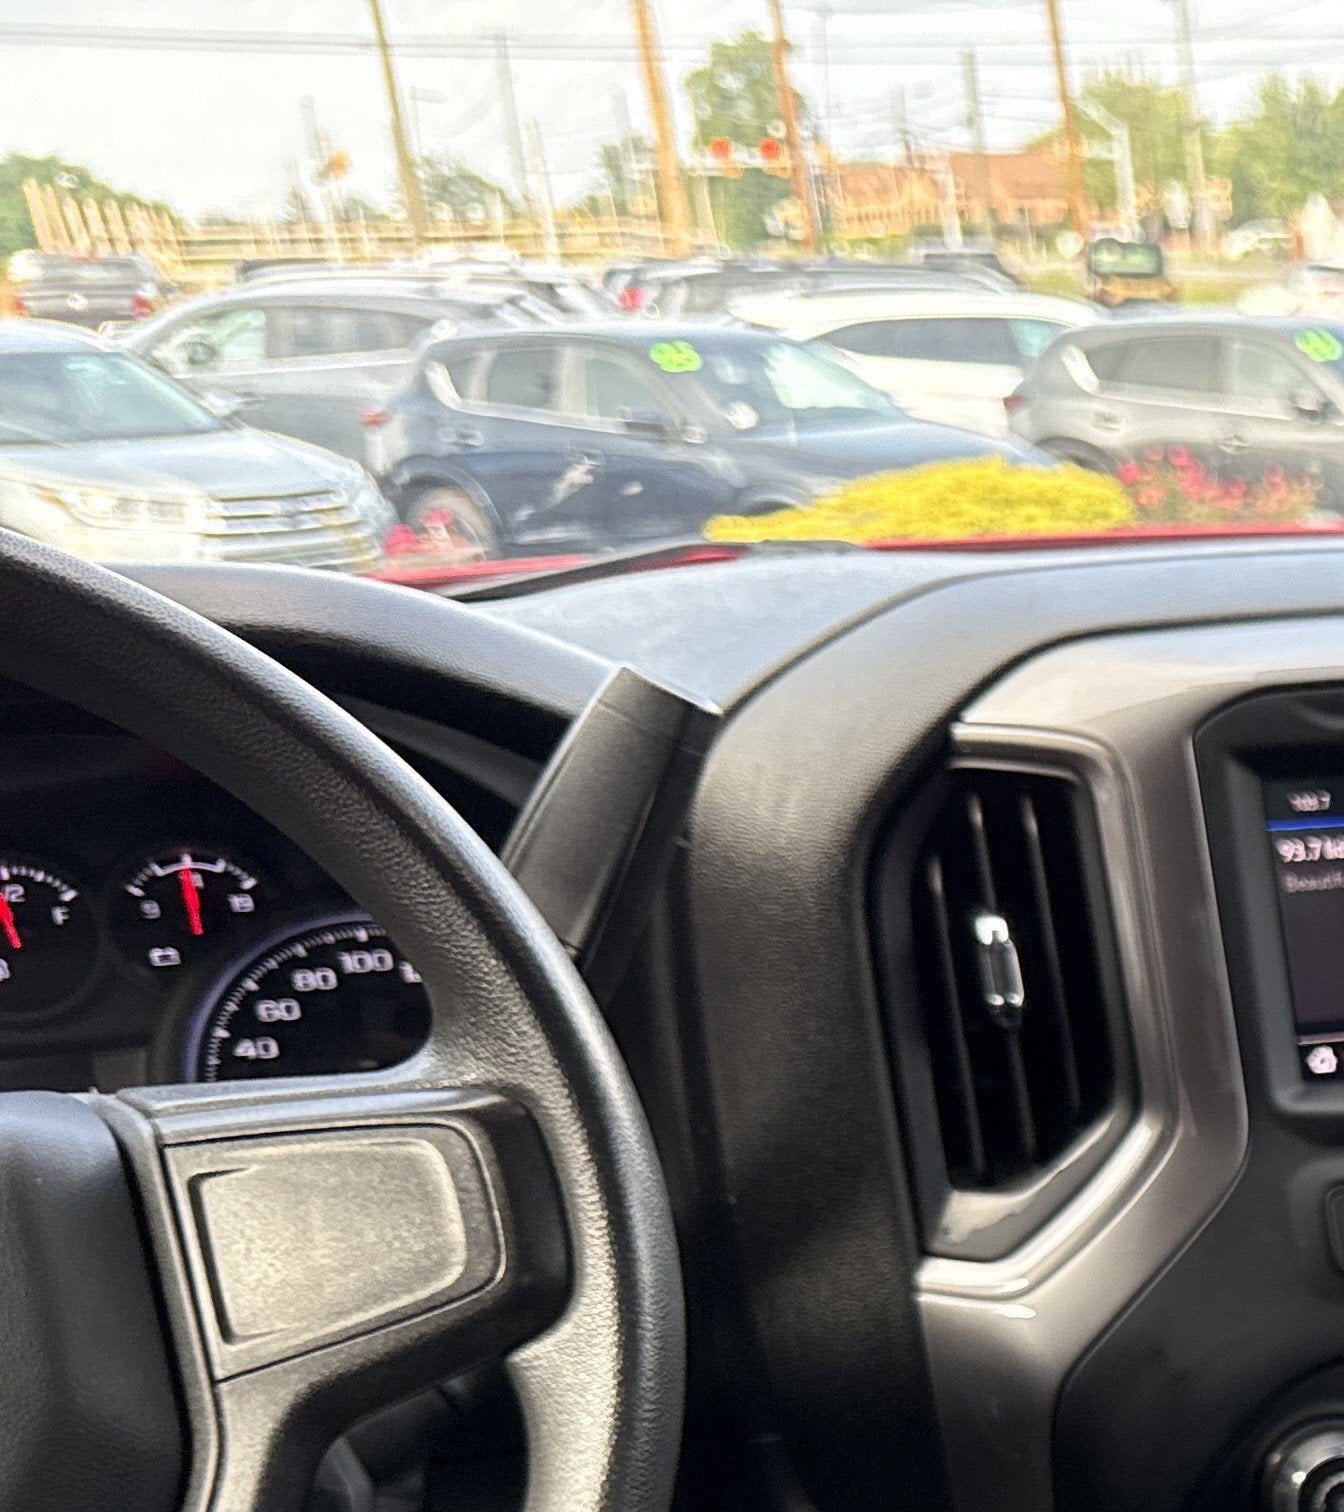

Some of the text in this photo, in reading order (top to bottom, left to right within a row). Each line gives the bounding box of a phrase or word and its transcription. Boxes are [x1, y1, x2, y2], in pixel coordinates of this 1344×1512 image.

[338, 949, 394, 974] 100
[291, 967, 338, 991] 80
[255, 998, 302, 1022] 60
[233, 1037, 279, 1060] 40
